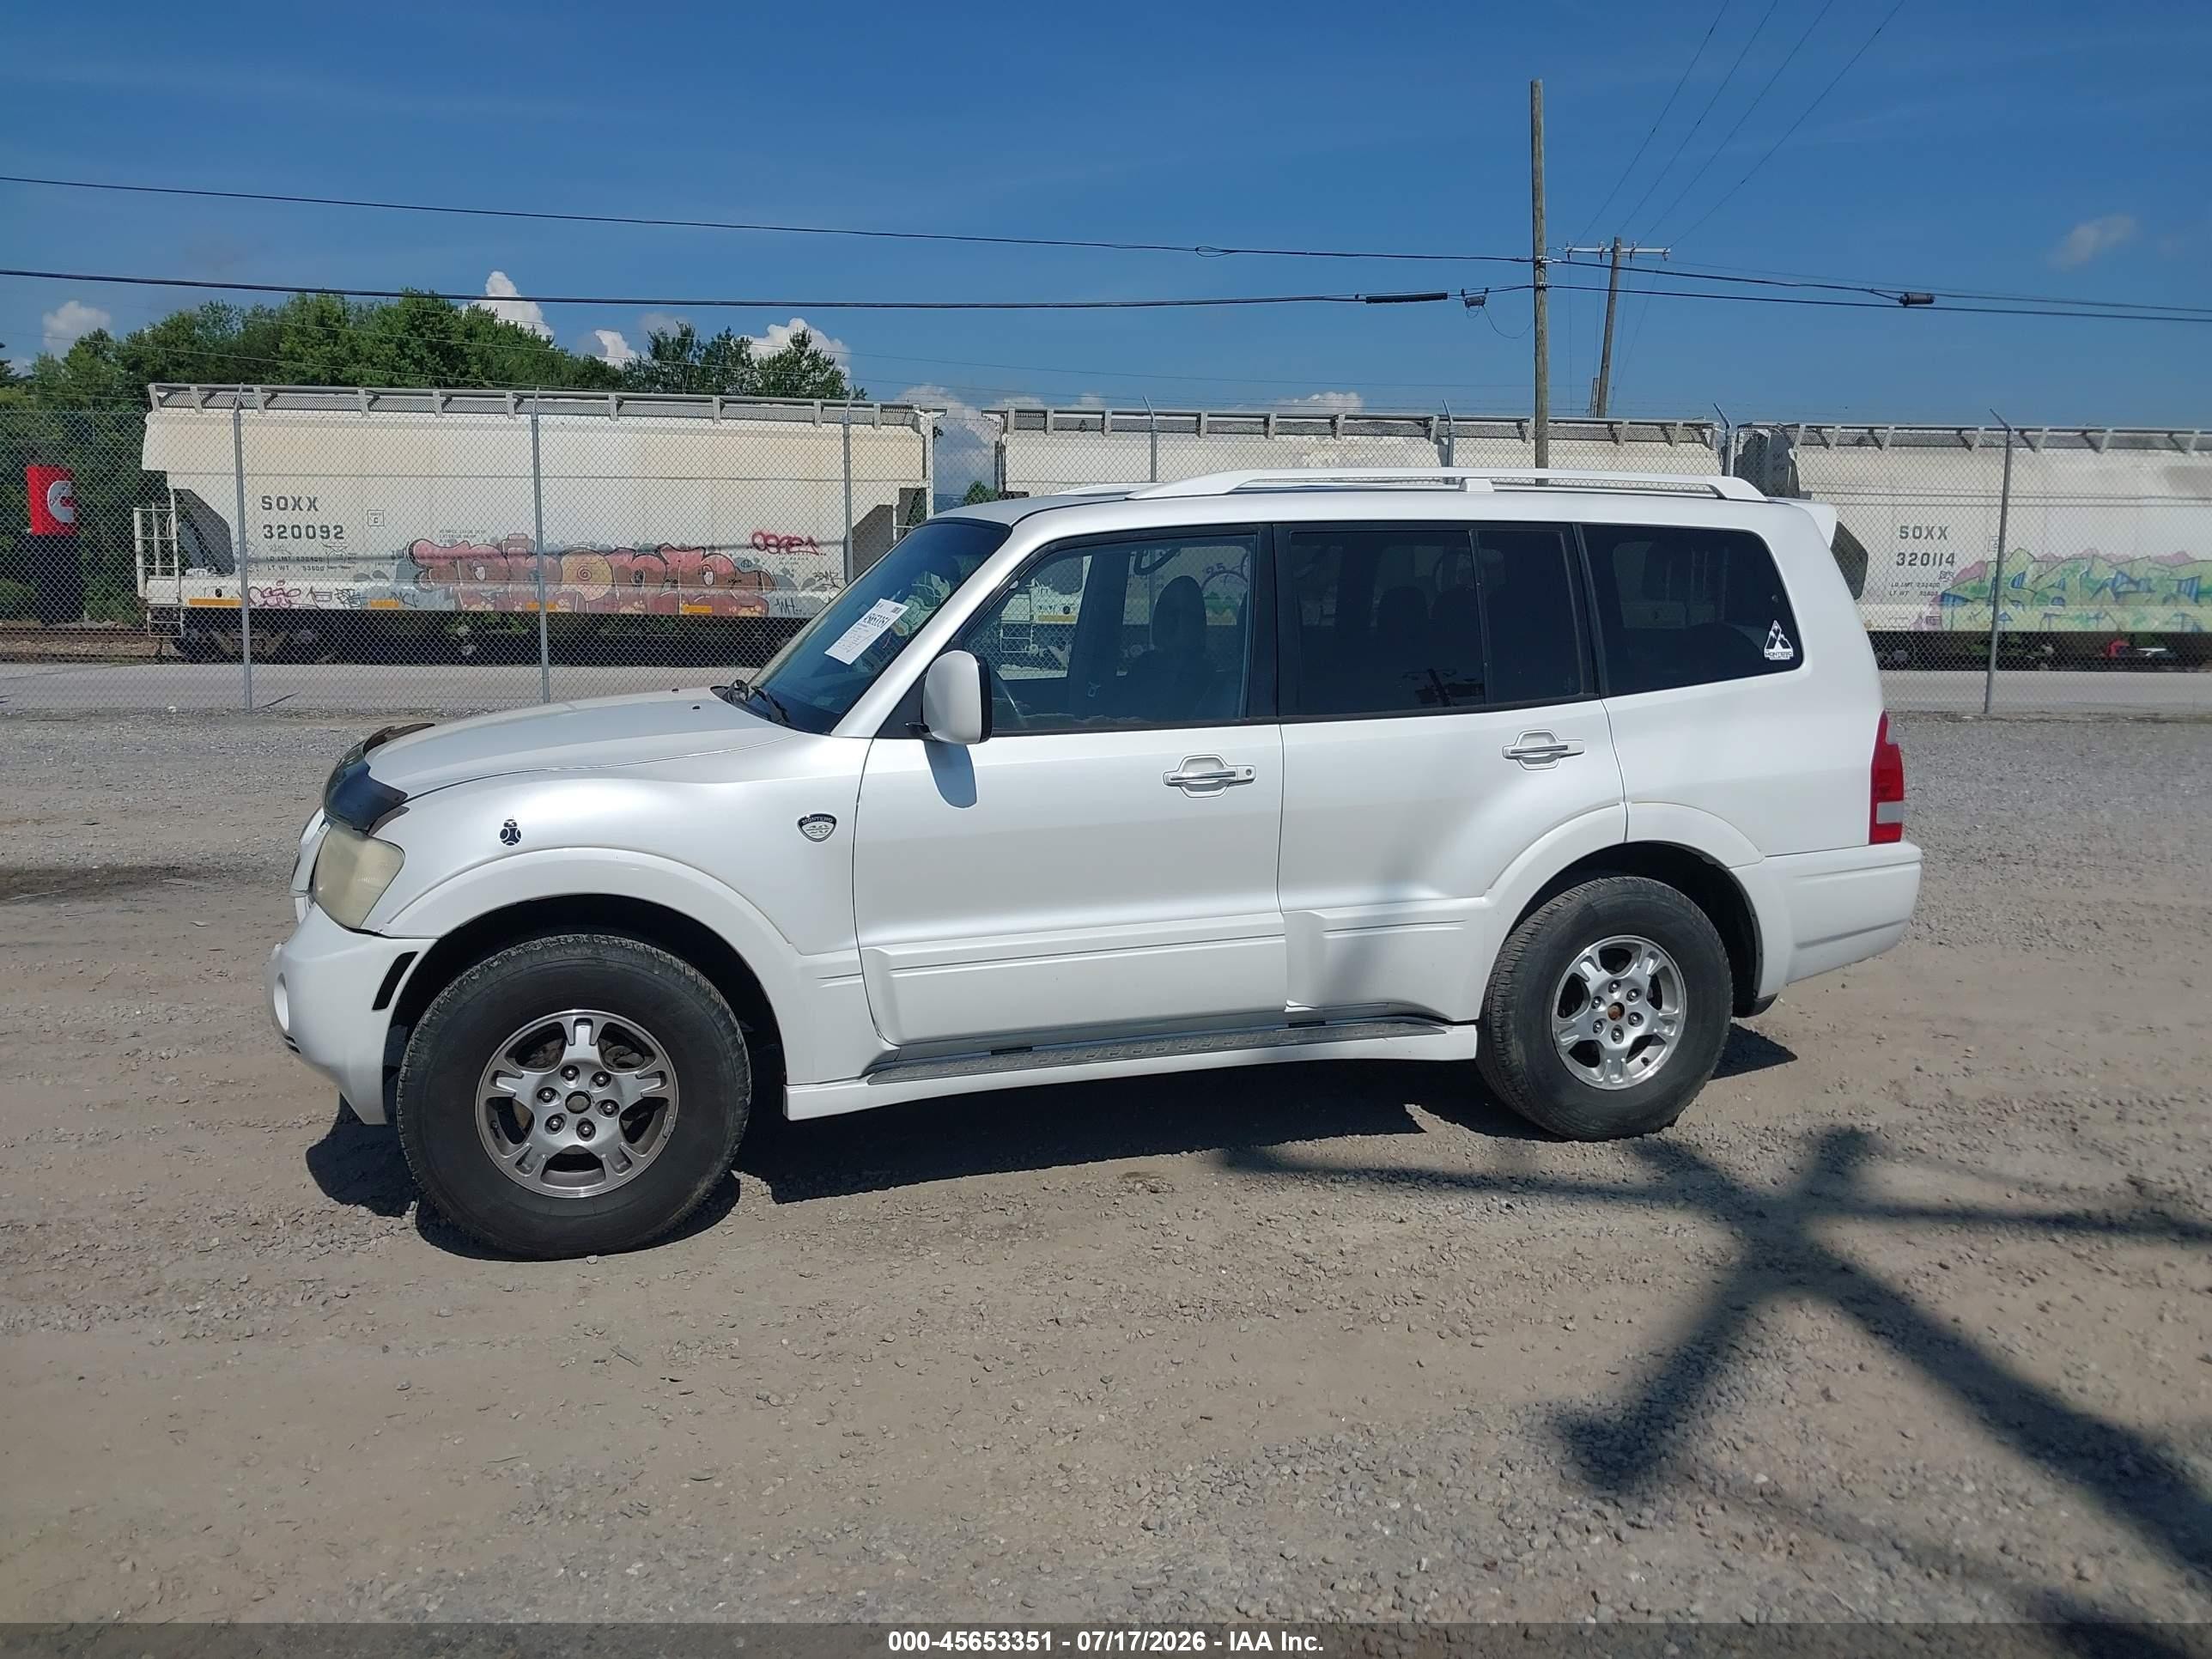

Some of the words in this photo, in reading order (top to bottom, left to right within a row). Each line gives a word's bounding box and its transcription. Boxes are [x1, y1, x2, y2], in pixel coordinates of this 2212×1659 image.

[261, 495, 319, 512] SOXX
[263, 524, 344, 539] 320092
[1899, 525, 1948, 540] SOXX
[1896, 552, 1955, 567] 320114
